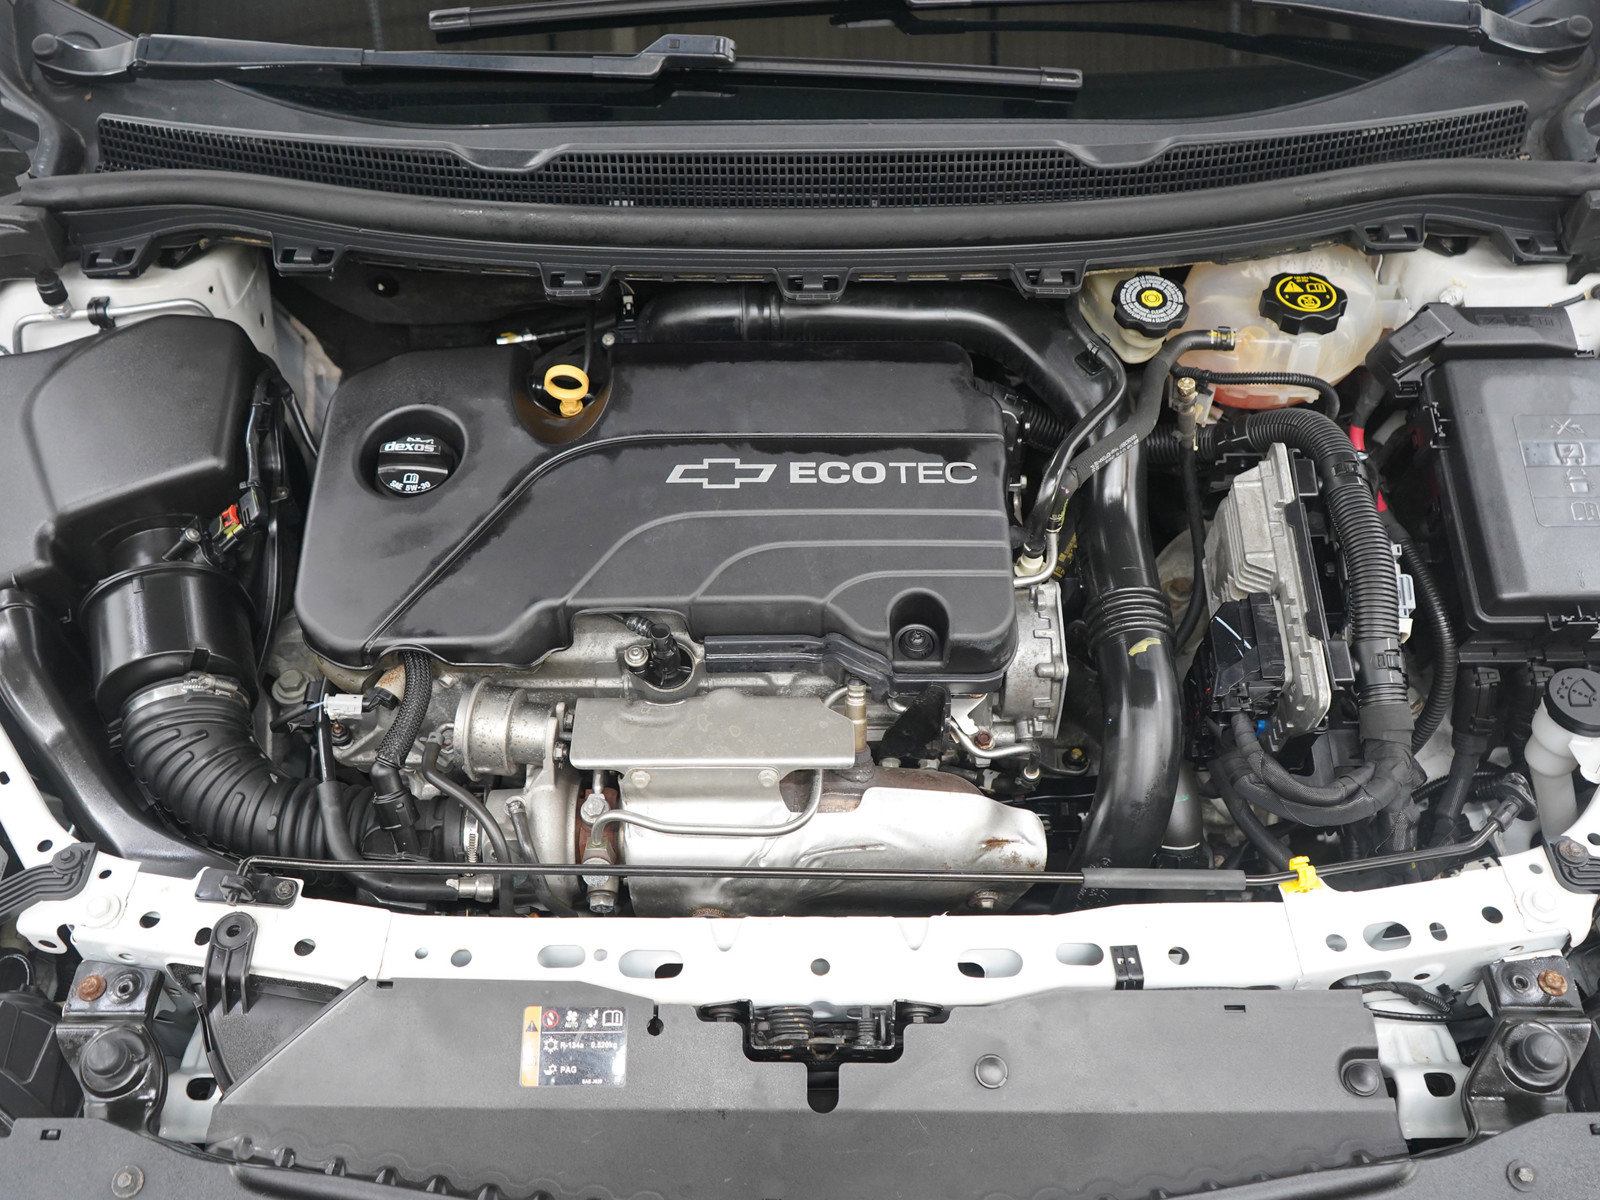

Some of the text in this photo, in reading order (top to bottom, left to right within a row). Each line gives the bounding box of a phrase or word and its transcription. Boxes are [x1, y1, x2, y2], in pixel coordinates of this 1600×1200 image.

[384, 441, 436, 452] dexos
[789, 461, 978, 484] ECOTEC
[389, 480, 431, 492] SAE 5W-30
[560, 1065, 577, 1074] PAG
